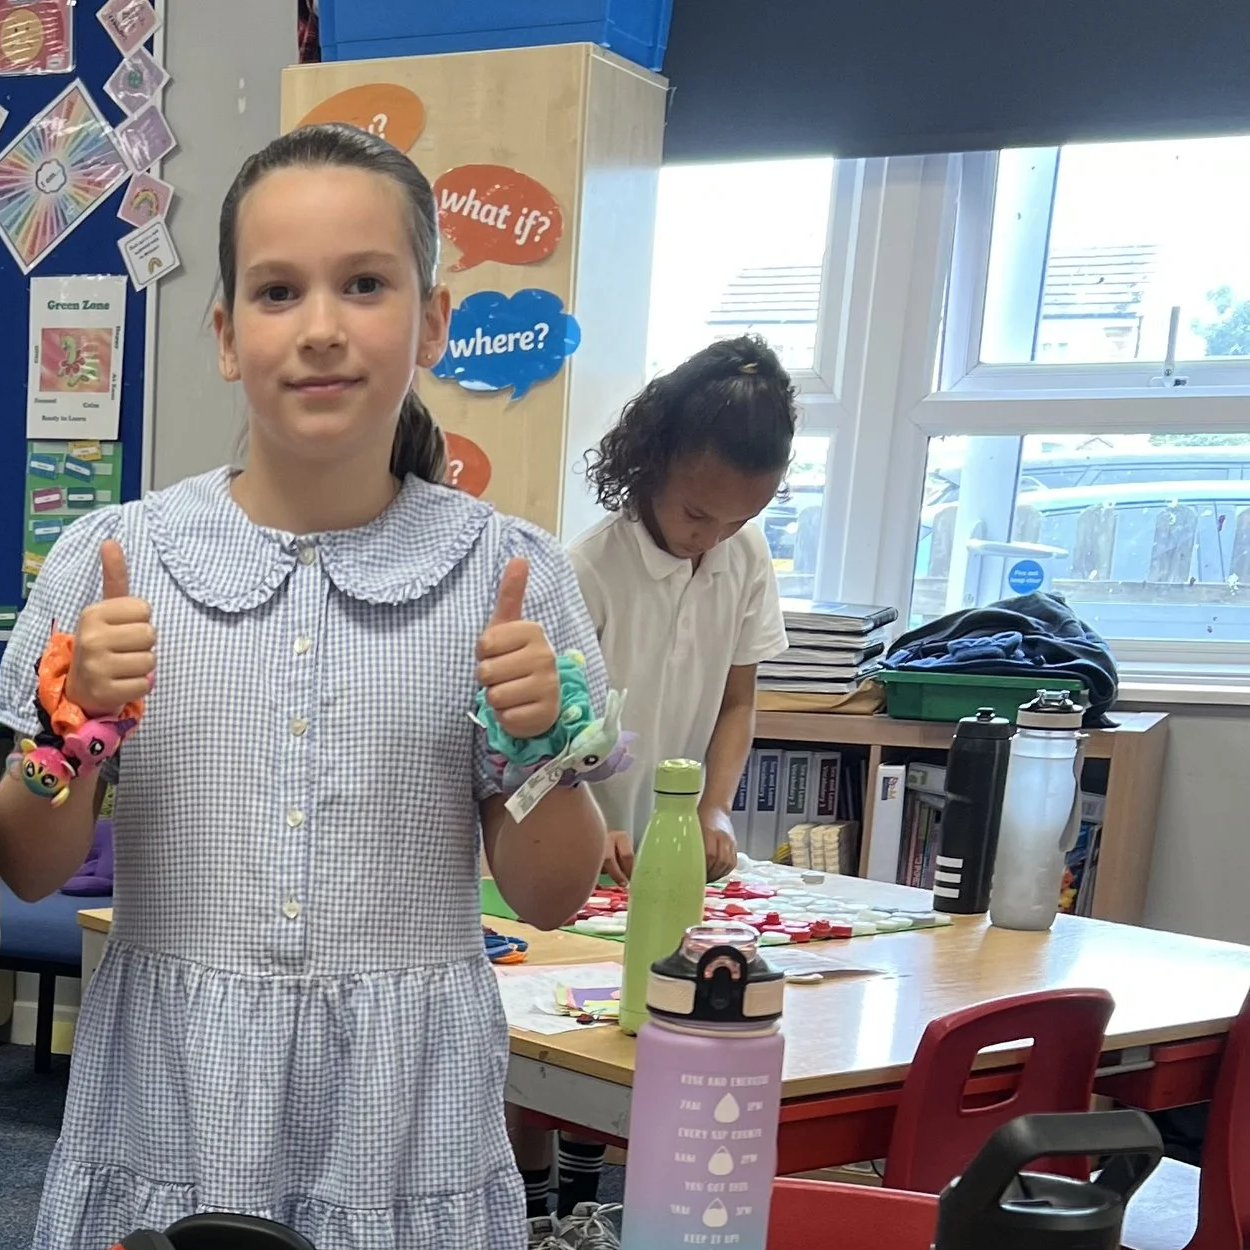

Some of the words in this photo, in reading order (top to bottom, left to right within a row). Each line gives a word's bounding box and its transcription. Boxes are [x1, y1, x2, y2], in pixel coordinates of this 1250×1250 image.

[440, 188, 512, 230] what
[513, 207, 551, 246] if?
[47, 300, 80, 311] Green
[82, 300, 110, 311] Zone
[450, 322, 550, 359] where?
[678, 1127, 708, 1139] EVERY
